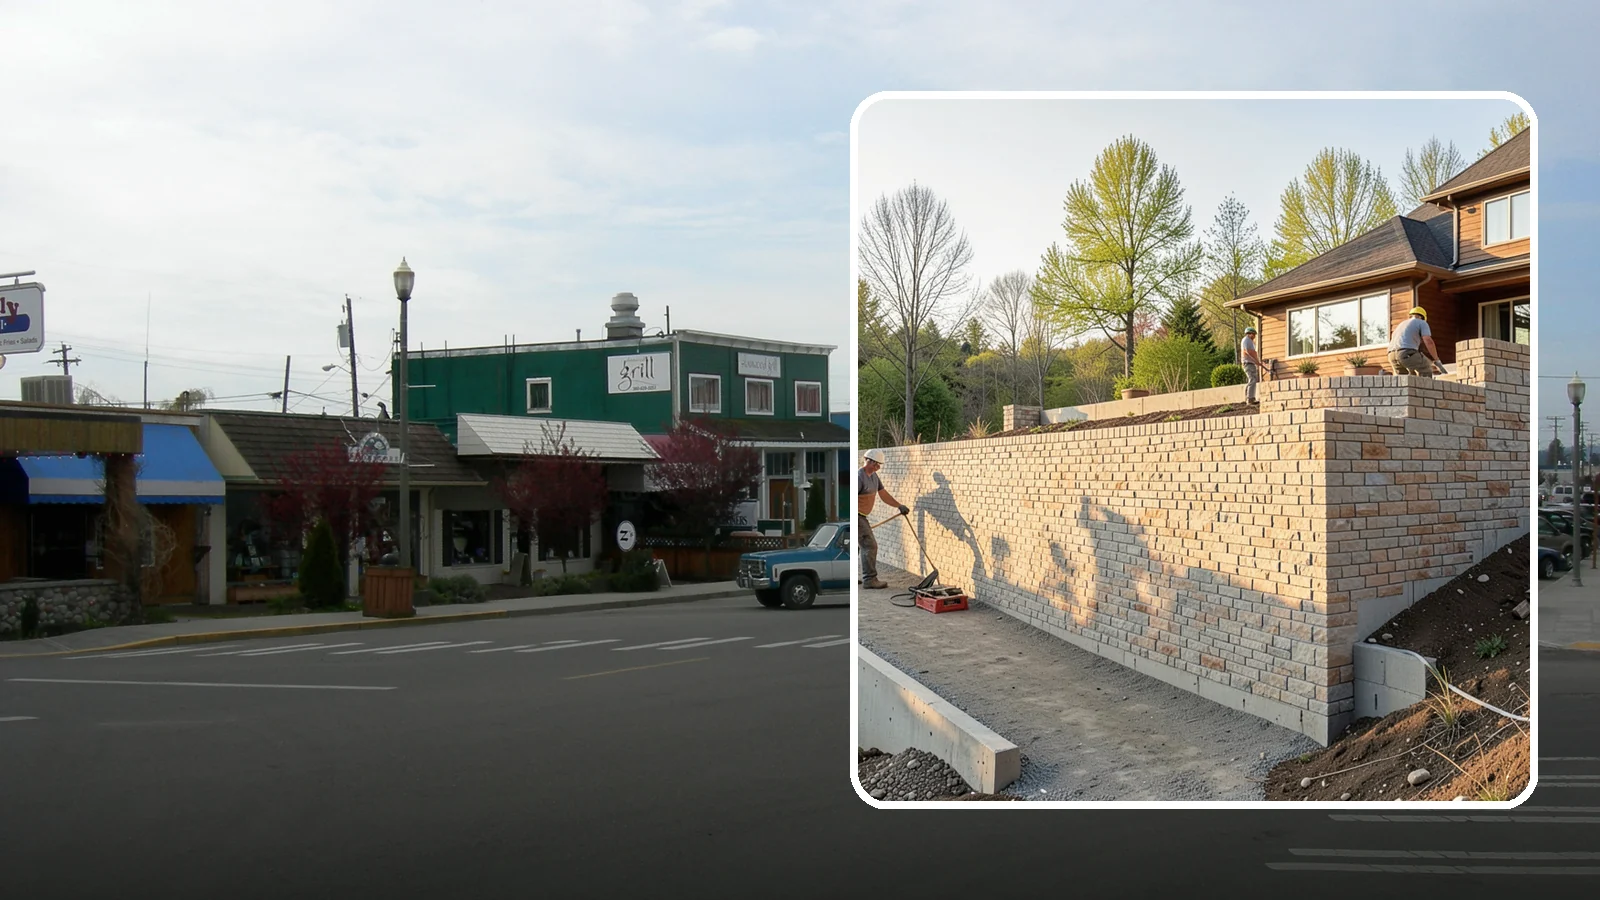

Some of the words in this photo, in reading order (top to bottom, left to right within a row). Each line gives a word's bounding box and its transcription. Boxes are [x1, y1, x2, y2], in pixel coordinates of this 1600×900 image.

[3, 338, 16, 346] Fries
[20, 337, 38, 345] Salads
[618, 356, 655, 391] grill
